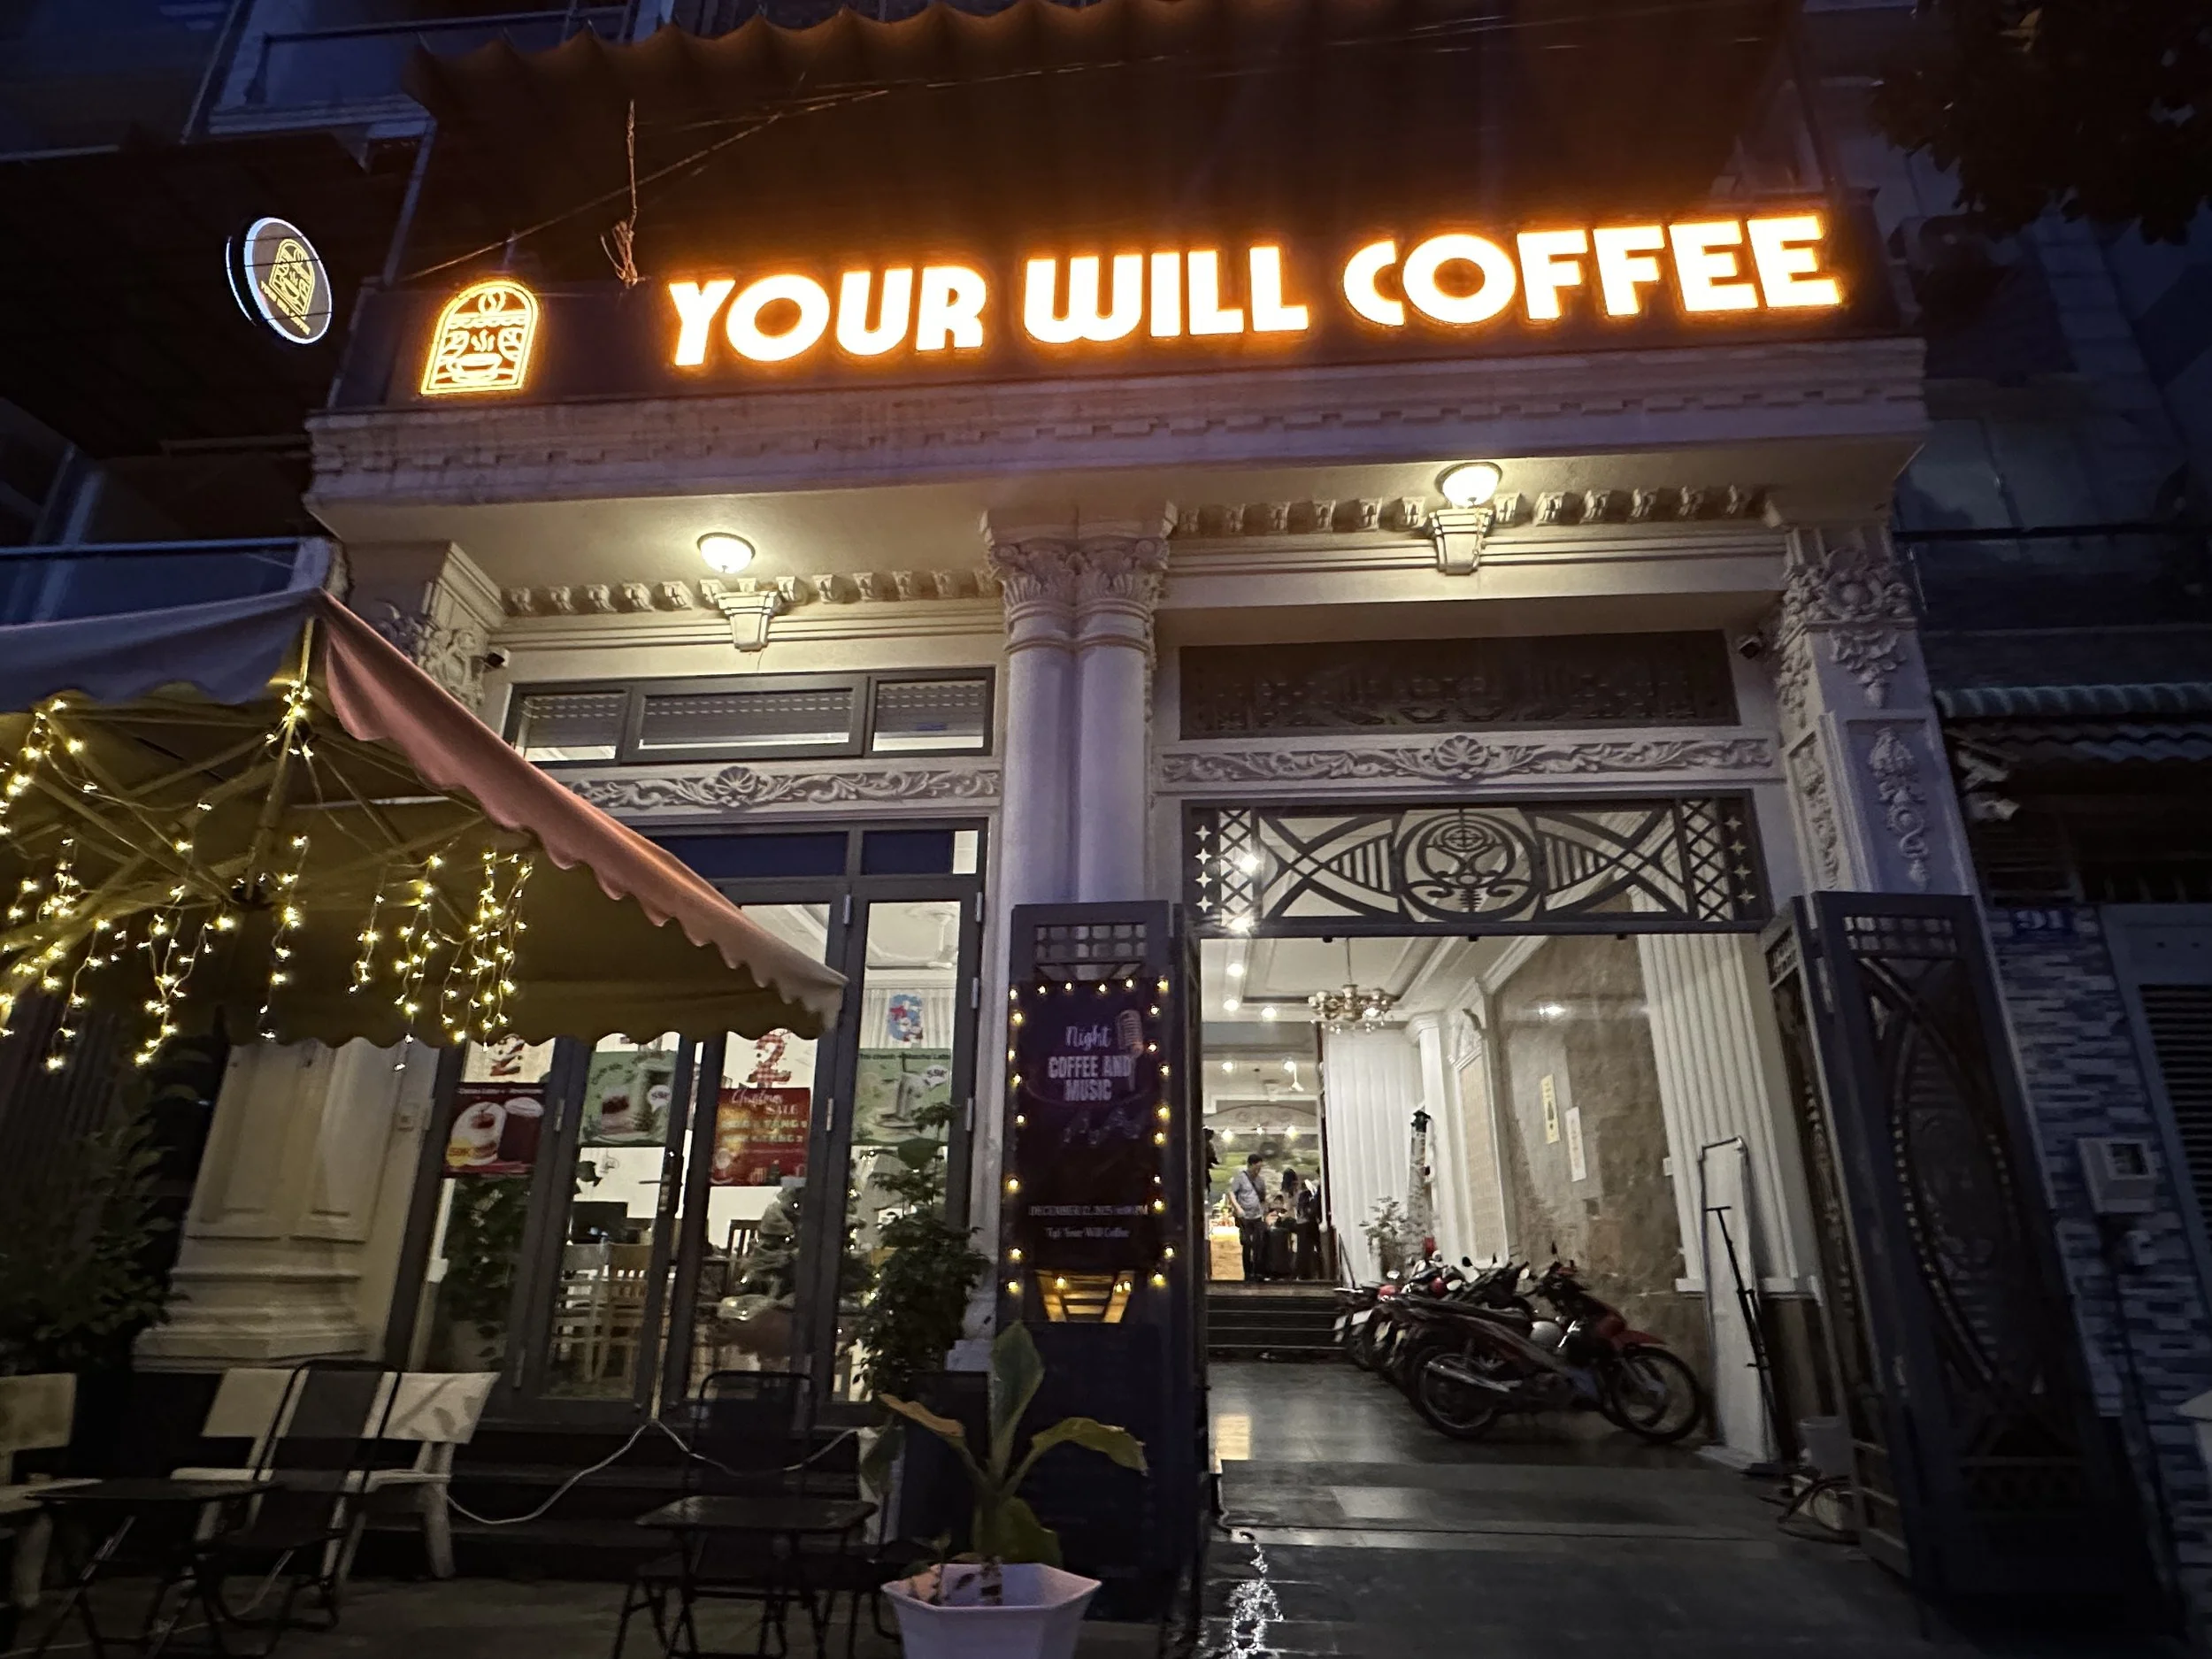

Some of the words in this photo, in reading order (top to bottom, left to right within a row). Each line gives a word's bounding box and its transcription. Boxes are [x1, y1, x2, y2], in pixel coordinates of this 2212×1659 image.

[668, 265, 987, 366] YOUR
[1024, 246, 1310, 344] WILL
[1343, 215, 1843, 327] COFFEE
[1064, 1025, 1112, 1051] Night
[1048, 1056, 1100, 1079] COFFEE
[1102, 1055, 1133, 1078] AND
[1064, 1079, 1113, 1102] MUSIC
